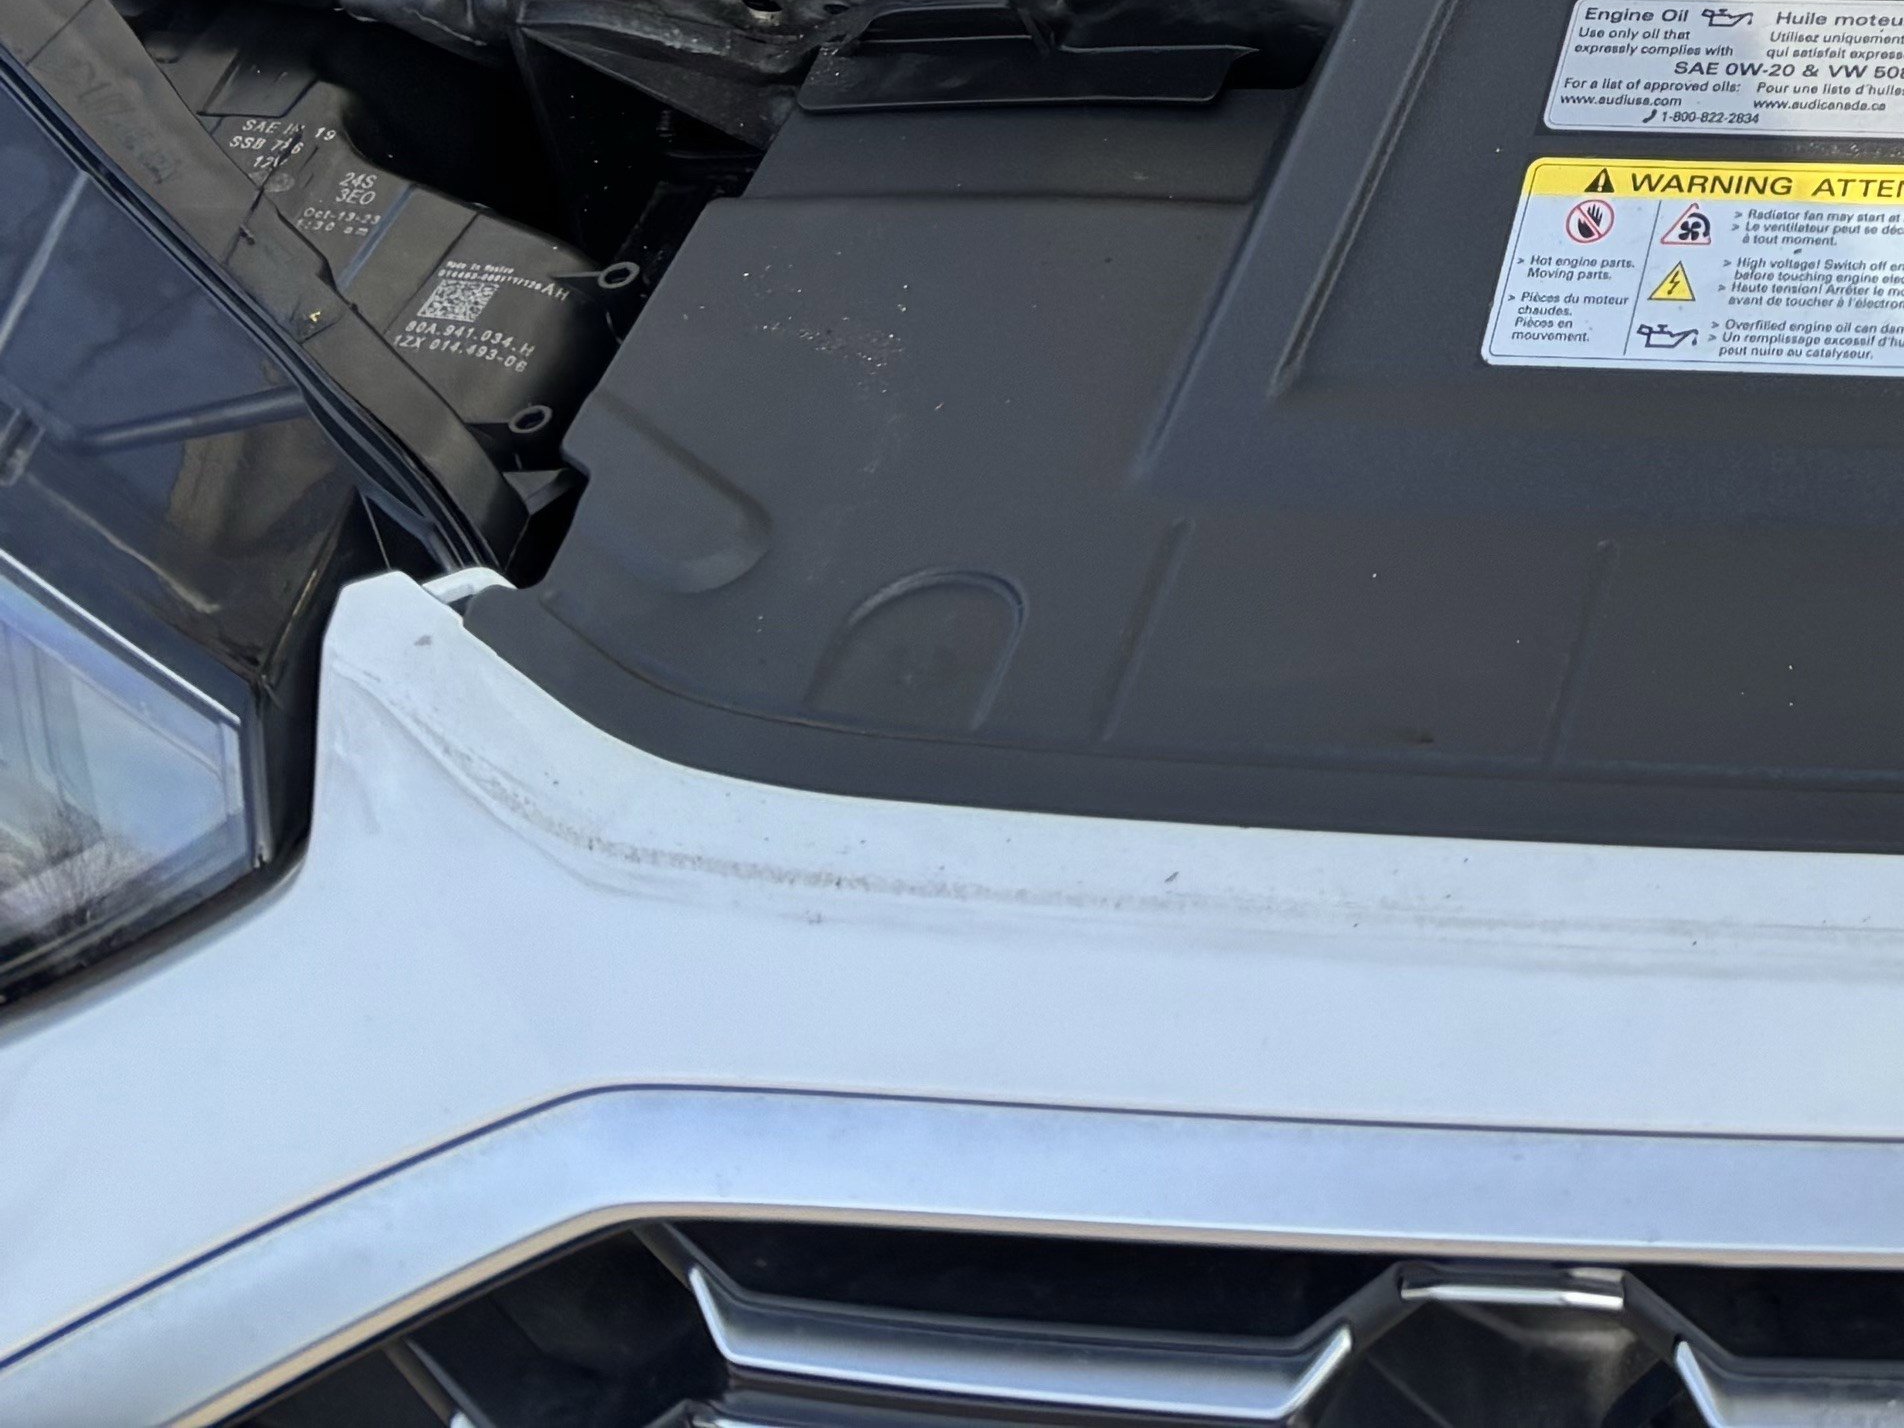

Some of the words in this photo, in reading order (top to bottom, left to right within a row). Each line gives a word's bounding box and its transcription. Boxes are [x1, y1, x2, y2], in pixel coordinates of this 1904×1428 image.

[1584, 7, 1654, 24] Engine
[1661, 8, 1689, 23] Oil
[1775, 11, 1828, 26] Huile
[1578, 26, 1605, 38] Use
[1608, 28, 1639, 41] only
[1642, 28, 1660, 39] oil
[1663, 29, 1691, 40] that
[1823, 32, 1904, 47] uniquement
[1574, 44, 1638, 56] expressly
[1640, 44, 1701, 57] complies
[1705, 45, 1733, 57] with
[1766, 47, 1789, 59] qui
[1792, 48, 1846, 60] satisfait
[1674, 61, 1720, 76] SAE
[1725, 62, 1795, 77] 0W-20
[1802, 64, 1819, 77] &
[1829, 65, 1867, 78] VW
[1564, 78, 1587, 89] For
[1602, 78, 1623, 90] list
[1626, 79, 1641, 90] of
[1643, 80, 1709, 94] approved
[1712, 81, 1741, 92] oils:
[1756, 82, 1790, 94] Pour
[1793, 85, 1818, 94] une
[1822, 83, 1851, 95] liste
[1560, 94, 1682, 107] www.audiusa.com
[1753, 99, 1886, 112] www.audicanada.ca
[1631, 172, 1793, 195] WARNING
[1748, 208, 1801, 221] Radiator
[1803, 210, 1824, 221] fan
[1826, 212, 1854, 225] may
[1857, 212, 1885, 223] start
[1888, 213, 1900, 223] at
[1745, 222, 1760, 232] Le
[1763, 222, 1829, 234] ventilateur
[1832, 224, 1860, 237] peut
[1864, 226, 1876, 236] se
[1753, 235, 1778, 245] tout
[1781, 236, 1838, 246] moment.
[1530, 255, 1552, 266] Hot
[1555, 257, 1597, 269] engine
[1600, 258, 1635, 269] parts.
[1737, 257, 1766, 270] High
[1769, 258, 1820, 272] voltage!
[1824, 259, 1867, 271] Switch
[1869, 260, 1888, 272] off
[1527, 267, 1574, 281] Moving
[1577, 269, 1612, 281] parts.
[1734, 269, 1775, 281] before
[1777, 271, 1833, 284] touching
[1836, 273, 1879, 286] engine
[1731, 282, 1768, 293] Haute
[1771, 282, 1822, 294] tension!
[1873, 285, 1885, 295] le
[1520, 291, 1560, 303] Pièces
[1564, 293, 1580, 304] du
[1583, 294, 1629, 305] moteur
[1728, 296, 1764, 306] avant
[1766, 296, 1782, 306] de
[1785, 296, 1833, 307] toucher
[1517, 304, 1573, 316] chaudes.
[1557, 319, 1573, 328] en
[1725, 318, 1786, 332] Overfilled
[1789, 321, 1832, 335] engine
[1836, 320, 1853, 332] oil
[1855, 324, 1877, 334] can
[1511, 331, 1589, 343] mouvement.
[1721, 332, 1741, 342] Un
[1744, 333, 1820, 347] remplissage
[1823, 334, 1875, 346] excessif
[1718, 345, 1747, 358] peut
[1750, 346, 1784, 358] nuire
[1787, 348, 1802, 358] au
